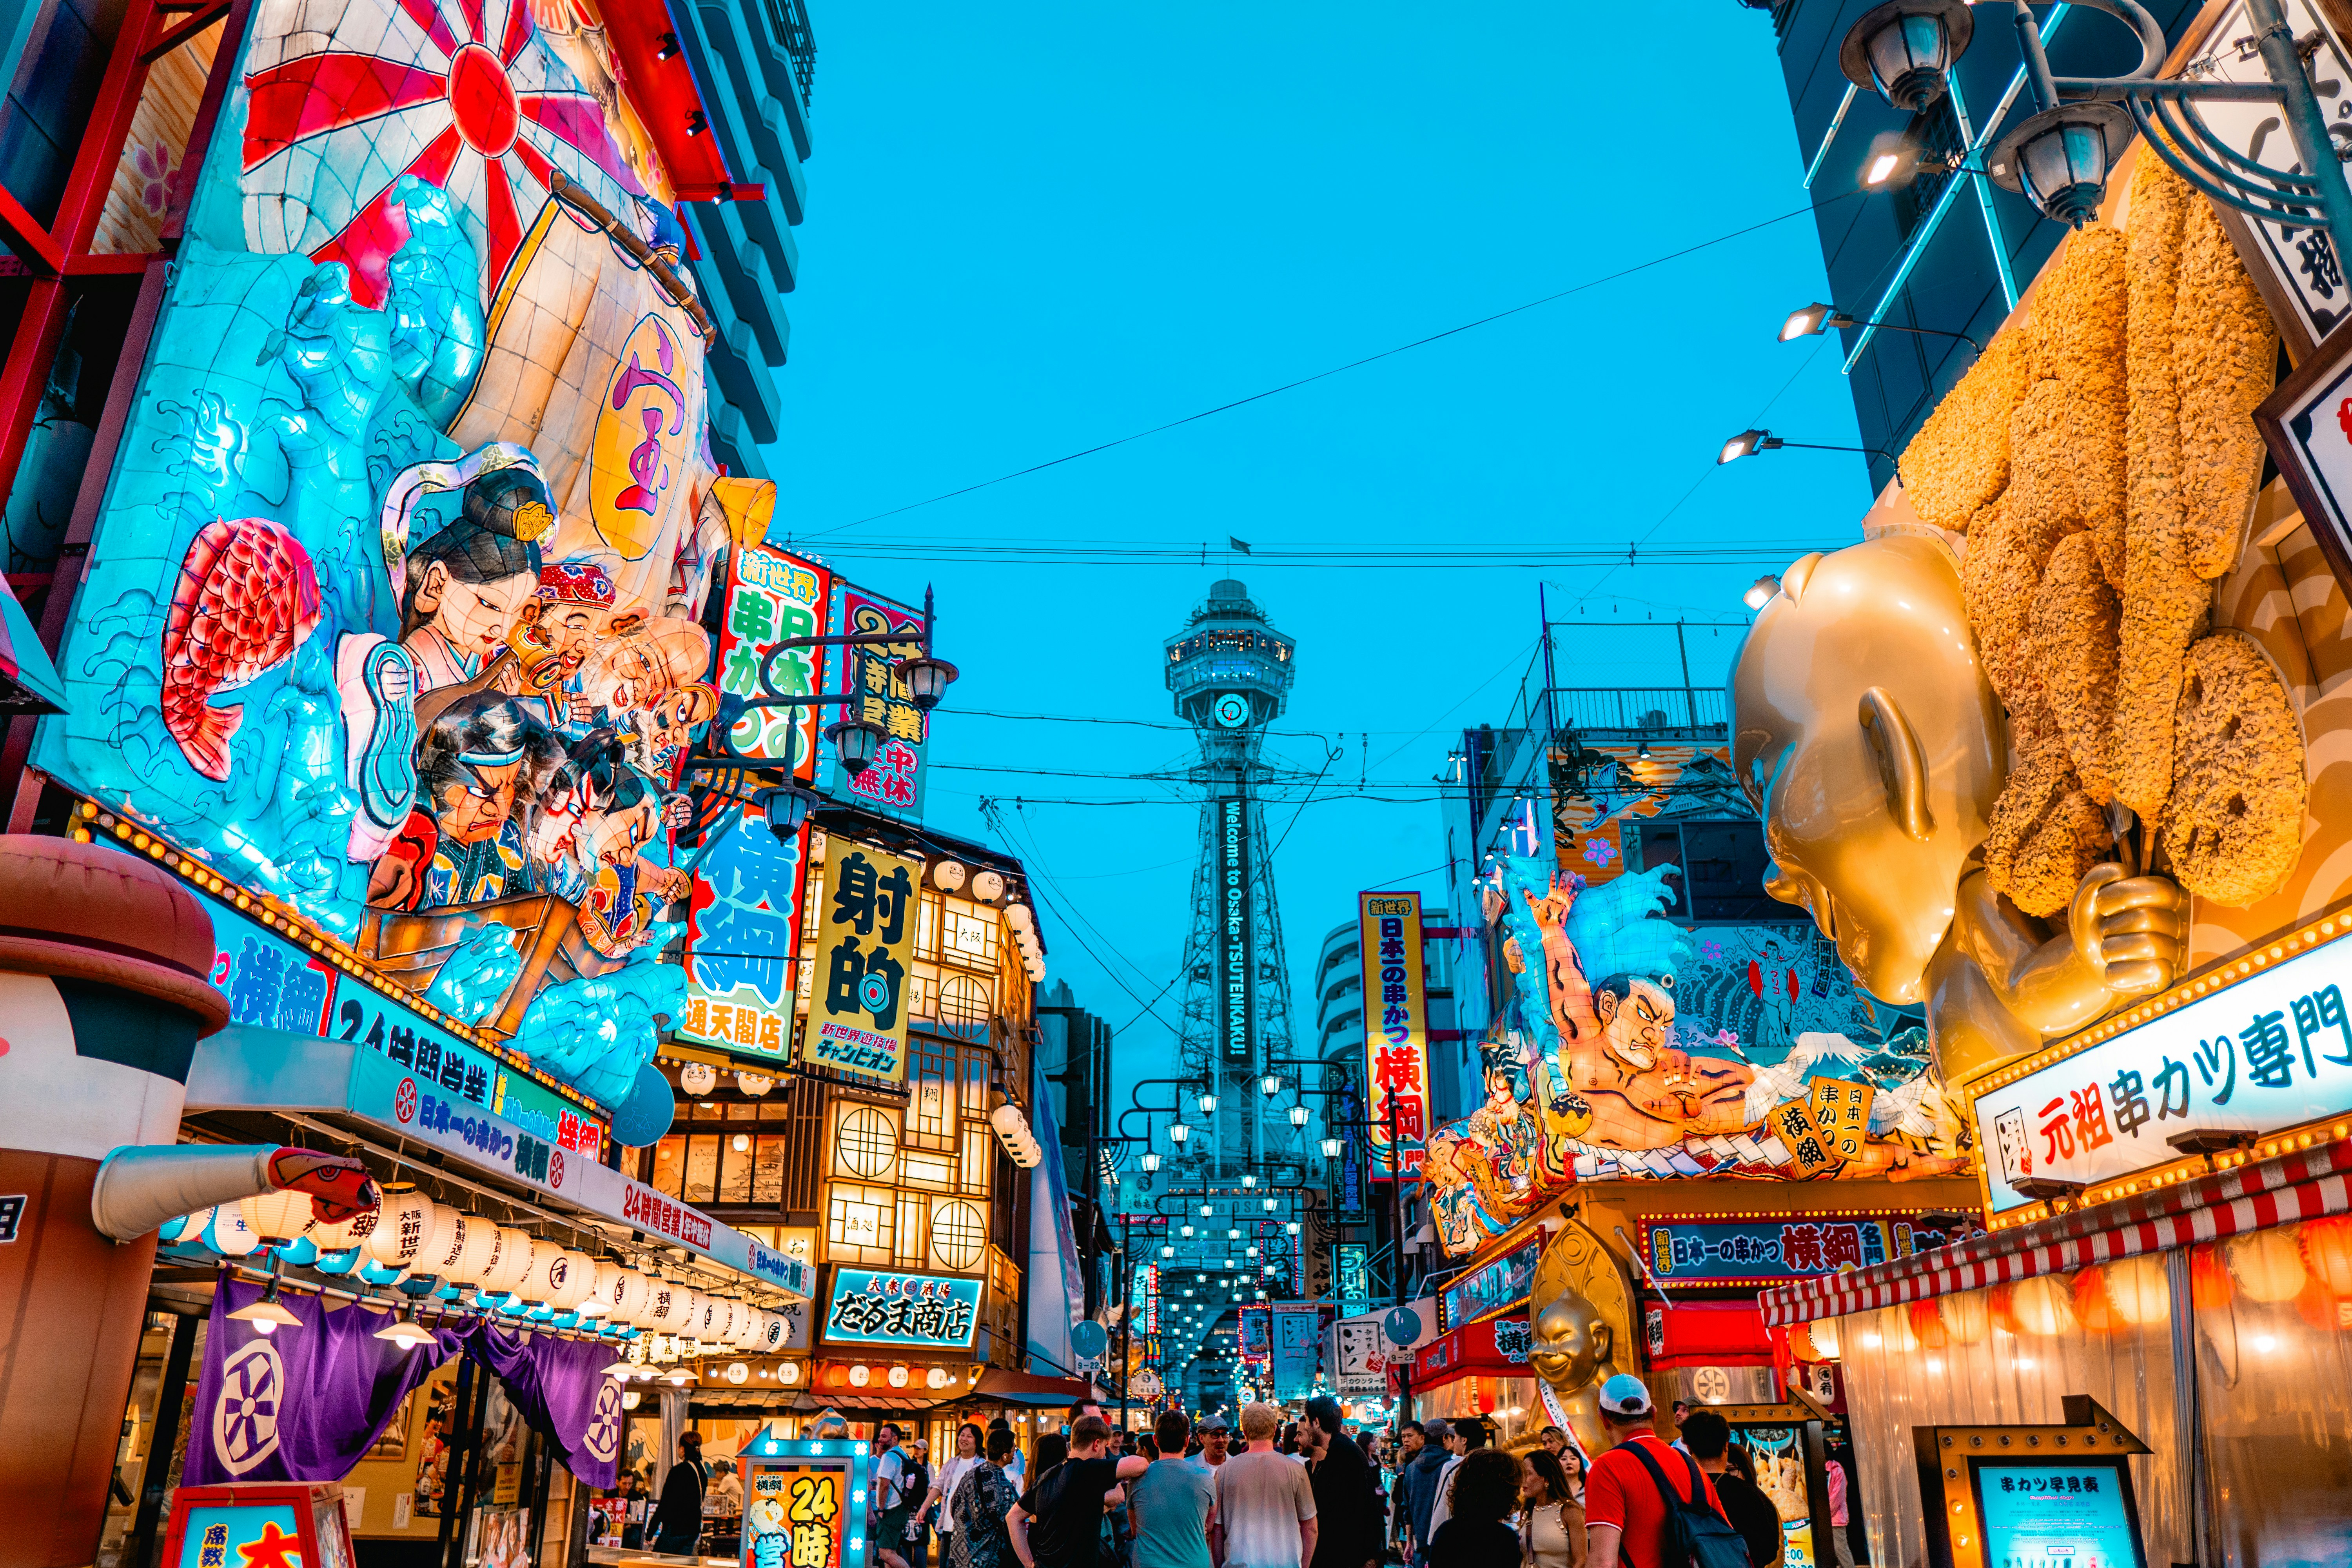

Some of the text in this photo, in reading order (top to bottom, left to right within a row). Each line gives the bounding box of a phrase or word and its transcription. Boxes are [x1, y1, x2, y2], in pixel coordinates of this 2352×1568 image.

[740, 552, 817, 603] 新世界
[854, 610, 923, 661] 24
[726, 591, 773, 748] 串かつ
[855, 769, 913, 802] 無休
[1226, 801, 1241, 866] Welcome
[1227, 871, 1239, 886] to
[695, 808, 800, 1006] 横綱
[1369, 900, 1412, 916] 新世界
[826, 851, 913, 1031] 射的
[959, 927, 982, 945] 大阪
[231, 937, 327, 1032] 横綱
[1378, 918, 1411, 1044] 日本一の串かつ
[683, 997, 783, 1052] 通天閣店
[820, 1022, 898, 1053] 新世界遊技場
[339, 999, 488, 1103] 24時間営業
[816, 1039, 898, 1074] チャンピオン
[1373, 1045, 1425, 1143] 横綱
[1816, 1083, 1840, 1146] 串かつ
[419, 1094, 513, 1160] 日本一の串かつ
[556, 1109, 599, 1161] 横綱
[1780, 1107, 1826, 1171] 横綱
[1840, 1089, 1863, 1154] 日本一の
[235, 1219, 248, 1231] 生
[399, 1209, 422, 1221] 大阪
[623, 1184, 710, 1247] 24時間営業 年中無休
[846, 1216, 873, 1232] 酒処
[1232, 1201, 1285, 1213] OSAA
[397, 1221, 422, 1259] 新世界
[1655, 1229, 1673, 1274] 新世界
[1673, 1236, 1781, 1266] 日本一の串かつ
[1781, 1225, 1862, 1270] 横綱
[653, 1290, 671, 1319] 横綱
[829, 1290, 973, 1340] だるま商店
[1391, 1353, 1414, 1362] 9-22
[755, 1479, 782, 1491] 横綱
[2000, 1476, 2100, 1494] 串カツ早見表
[201, 1526, 227, 1567] 席数
